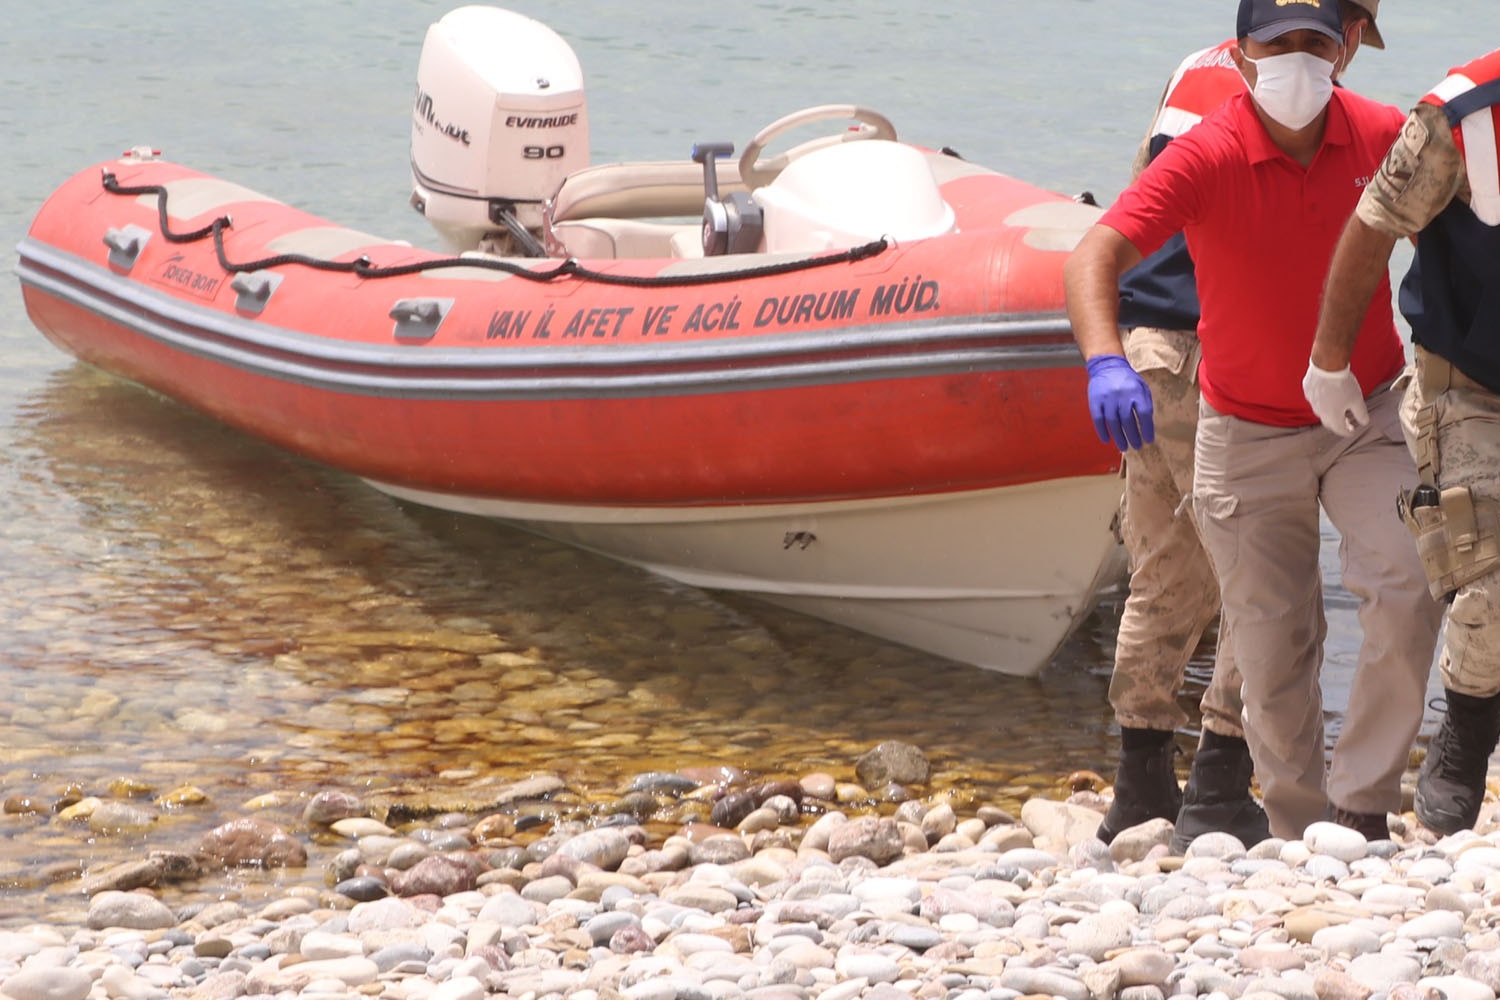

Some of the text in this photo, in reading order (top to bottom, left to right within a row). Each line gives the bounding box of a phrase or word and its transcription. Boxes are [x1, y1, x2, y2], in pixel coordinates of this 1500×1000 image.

[505, 113, 578, 128] EVINRUDE
[523, 145, 564, 160] 90
[486, 274, 940, 339] VAN İL AFET VE ACİL DURUM MÜD.
